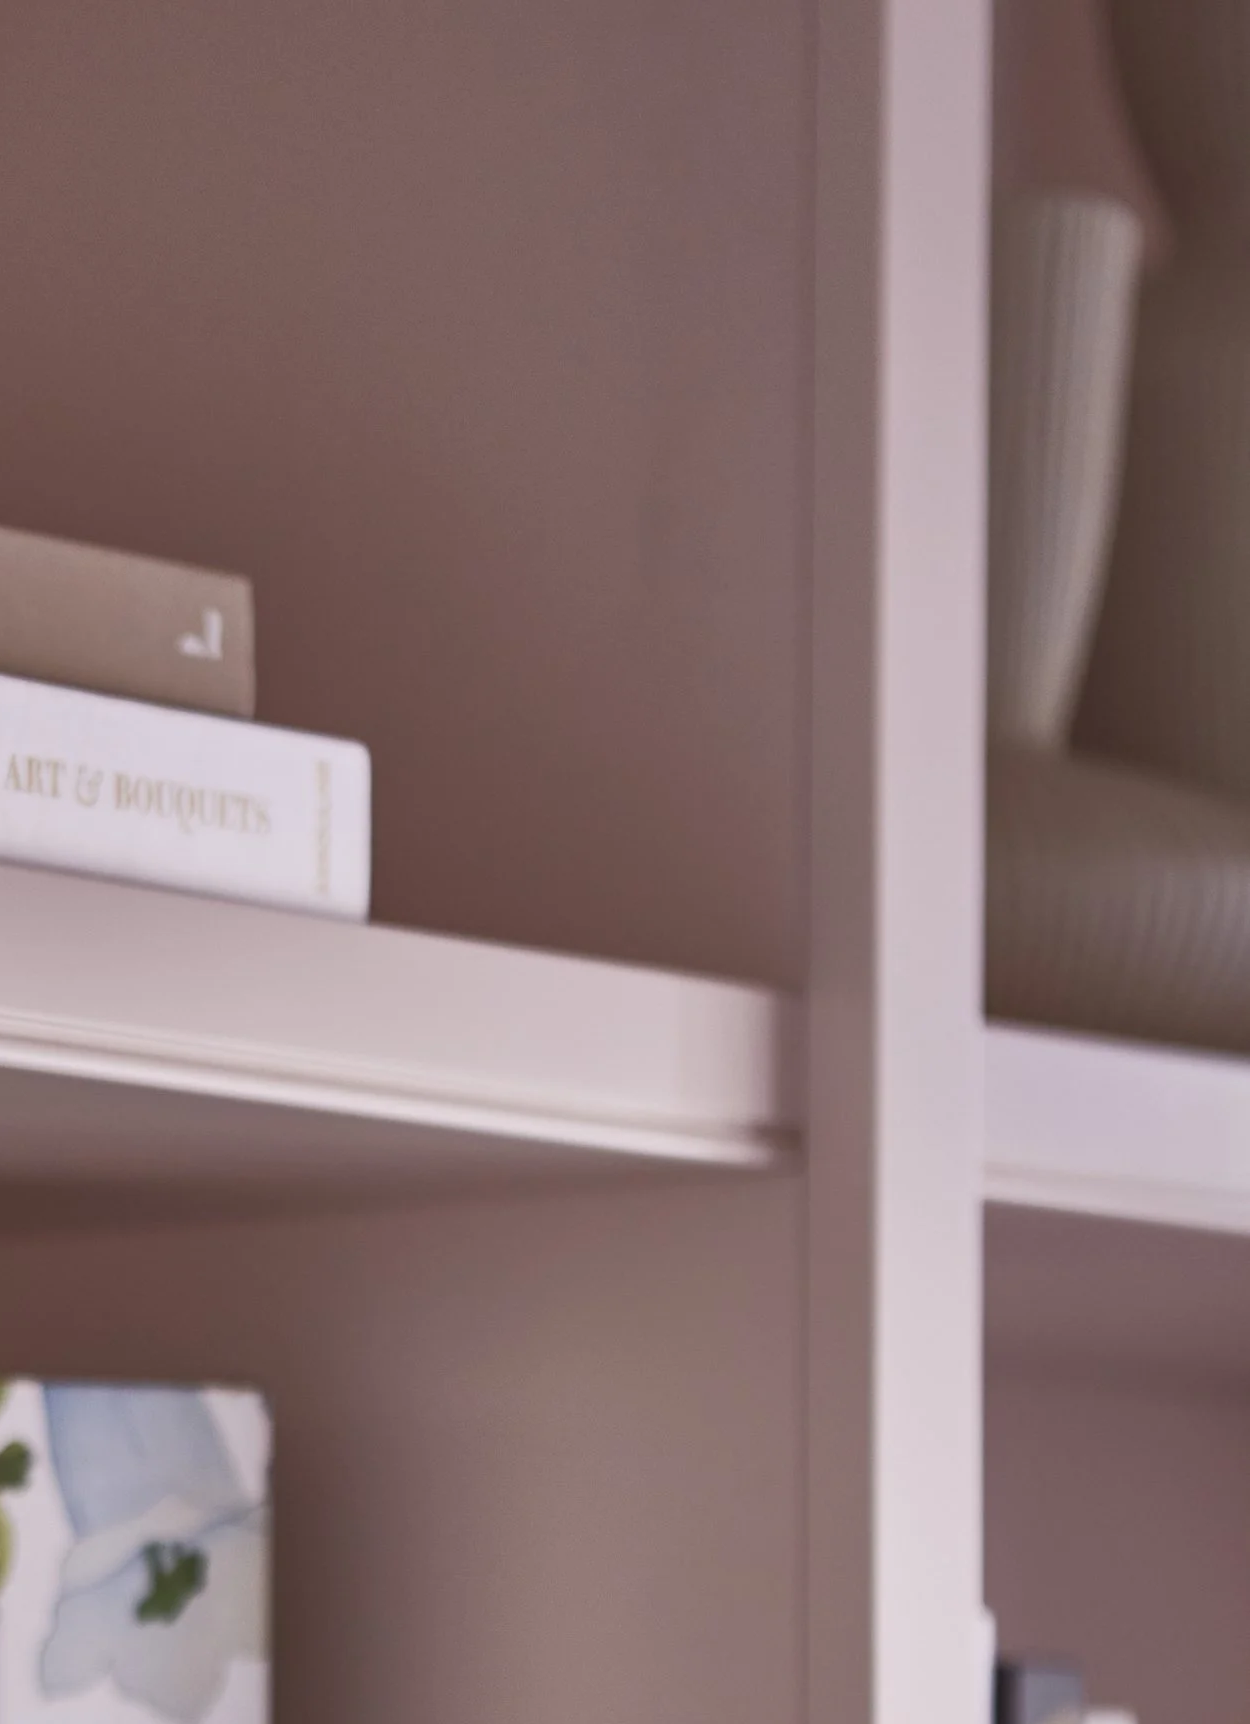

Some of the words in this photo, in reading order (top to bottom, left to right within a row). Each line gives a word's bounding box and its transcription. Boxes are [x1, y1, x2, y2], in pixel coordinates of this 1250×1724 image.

[2, 752, 66, 799] ART
[74, 764, 105, 808] &
[113, 772, 272, 837] BOUQUETS
